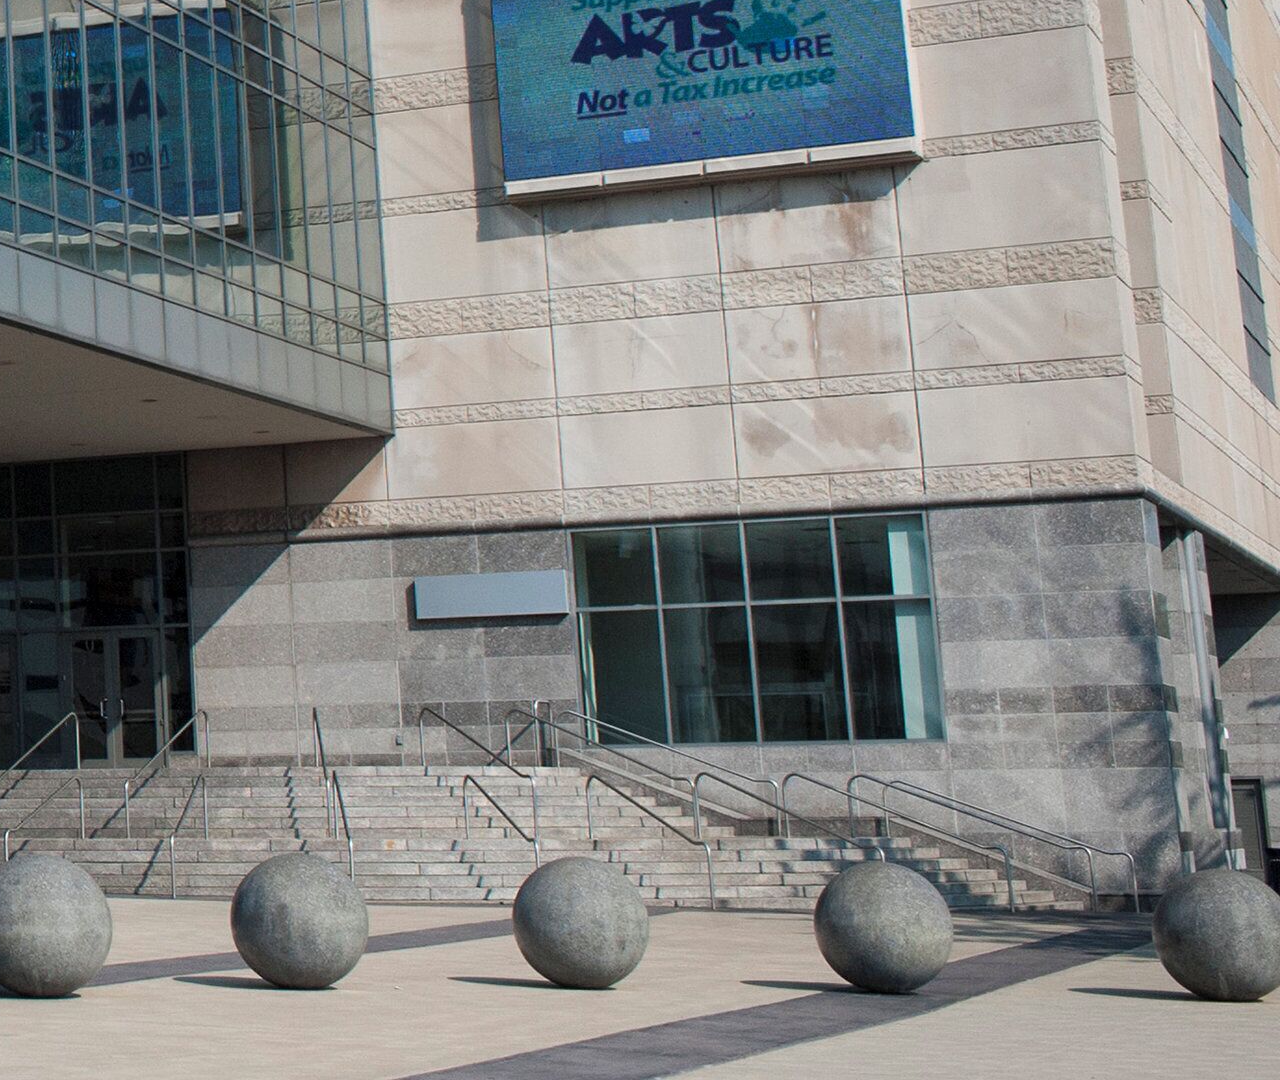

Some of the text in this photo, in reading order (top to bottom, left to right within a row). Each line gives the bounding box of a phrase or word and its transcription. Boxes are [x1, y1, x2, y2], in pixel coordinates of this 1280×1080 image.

[656, 33, 834, 78] & CULTURE
[576, 66, 836, 115] Not a Tax Increase
